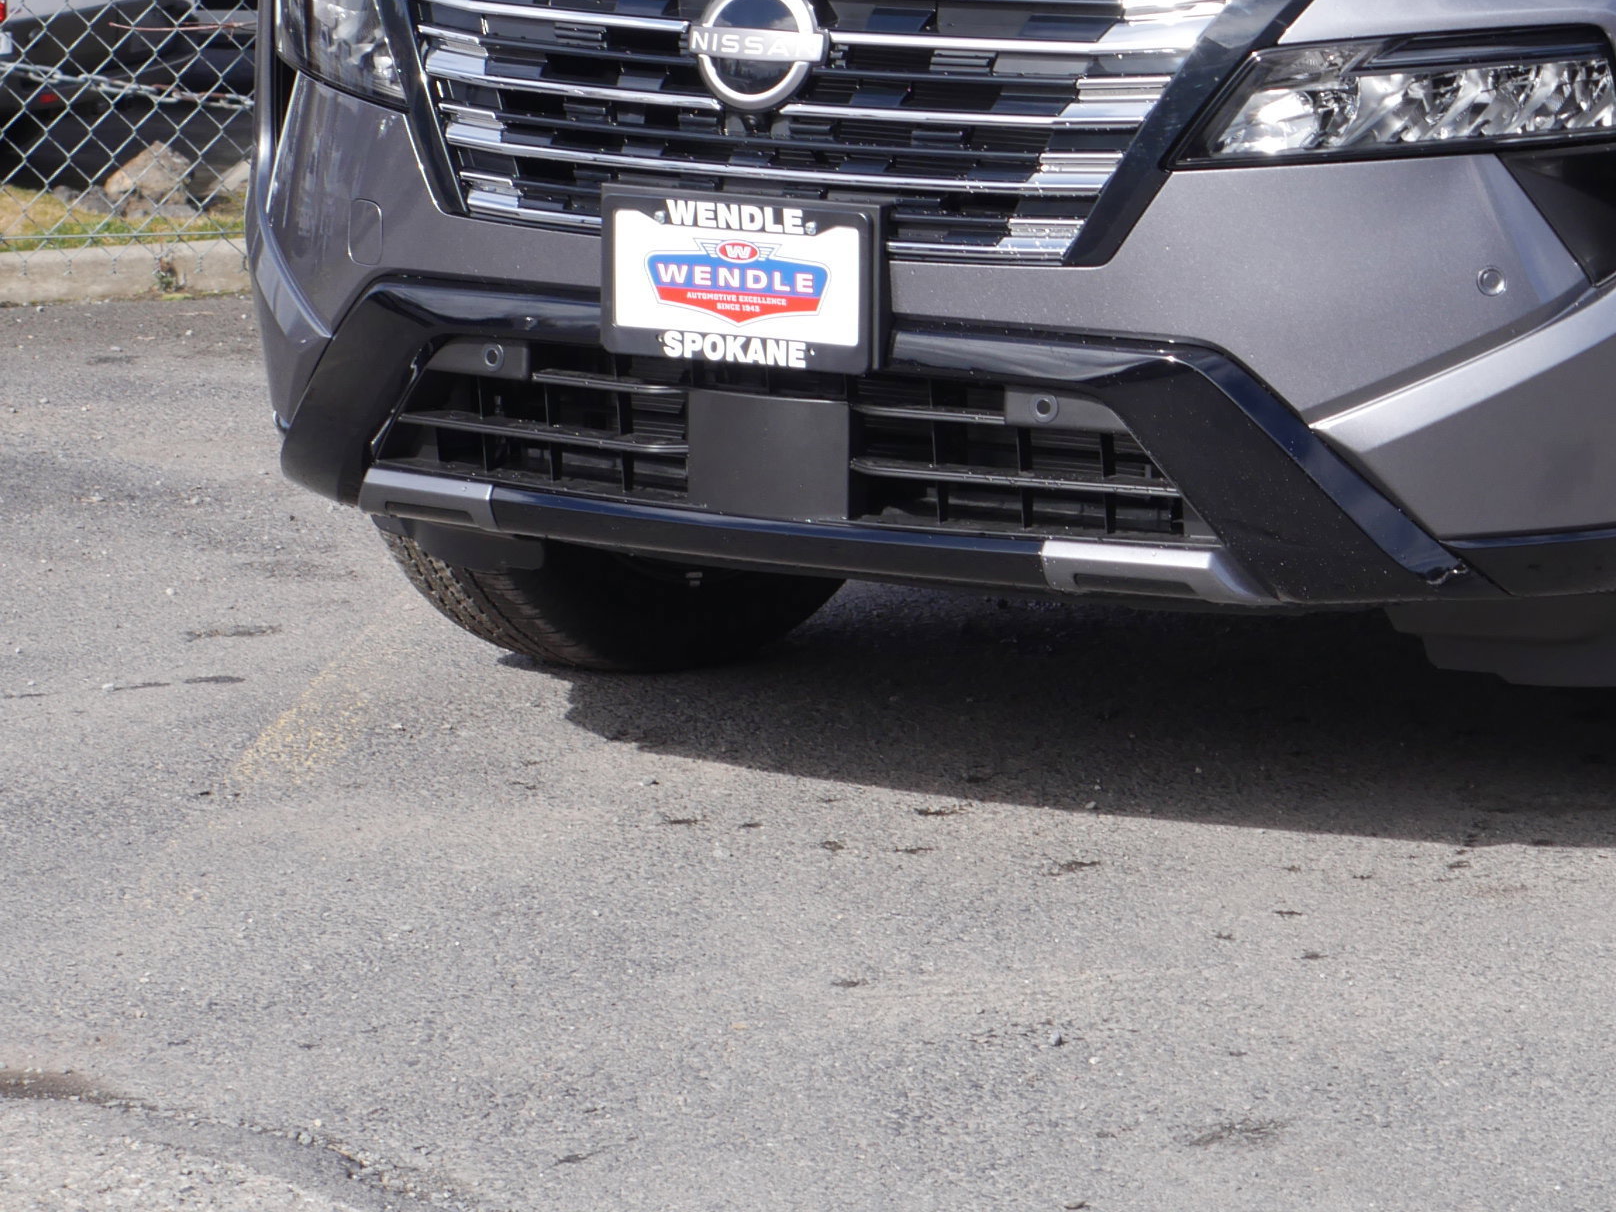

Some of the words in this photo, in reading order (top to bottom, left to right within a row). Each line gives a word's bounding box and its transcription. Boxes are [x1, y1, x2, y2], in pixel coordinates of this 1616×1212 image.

[690, 30, 819, 59] NISSAN
[665, 198, 805, 236] WENDLE
[655, 262, 815, 294] WENDLE
[686, 291, 738, 303] AUTOMOTIVE
[738, 294, 788, 306] EXCELLENCE
[716, 303, 741, 312] SINCE
[662, 330, 807, 369] SPOKANE
